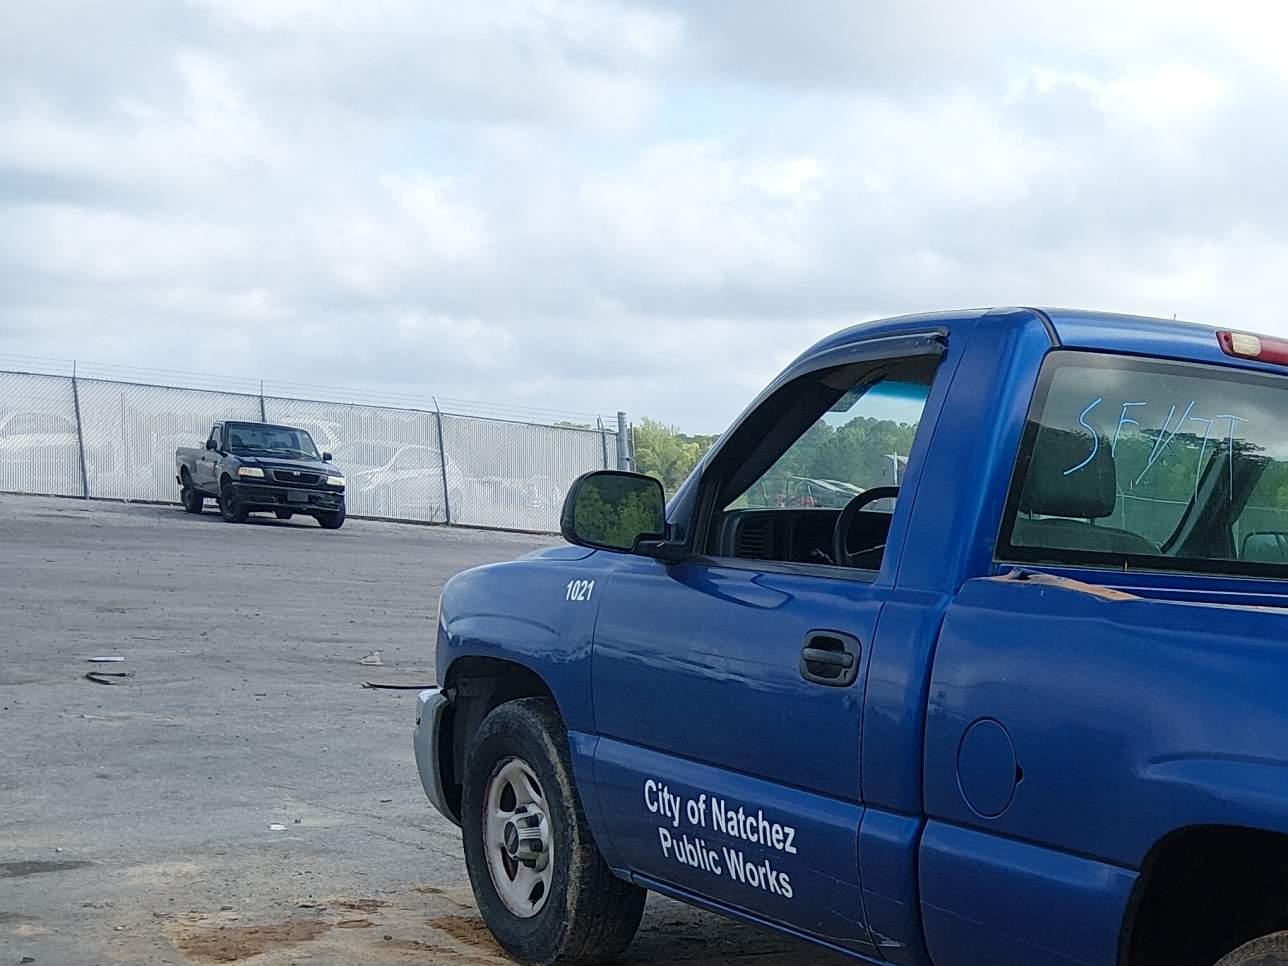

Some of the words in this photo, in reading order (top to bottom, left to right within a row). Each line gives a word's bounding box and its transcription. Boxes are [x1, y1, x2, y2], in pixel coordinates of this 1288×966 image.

[565, 579, 594, 601] 1021
[644, 779, 680, 828] City
[687, 794, 707, 827] of
[711, 797, 797, 854] Natchez
[658, 827, 721, 876] Public
[723, 847, 793, 898] Works
